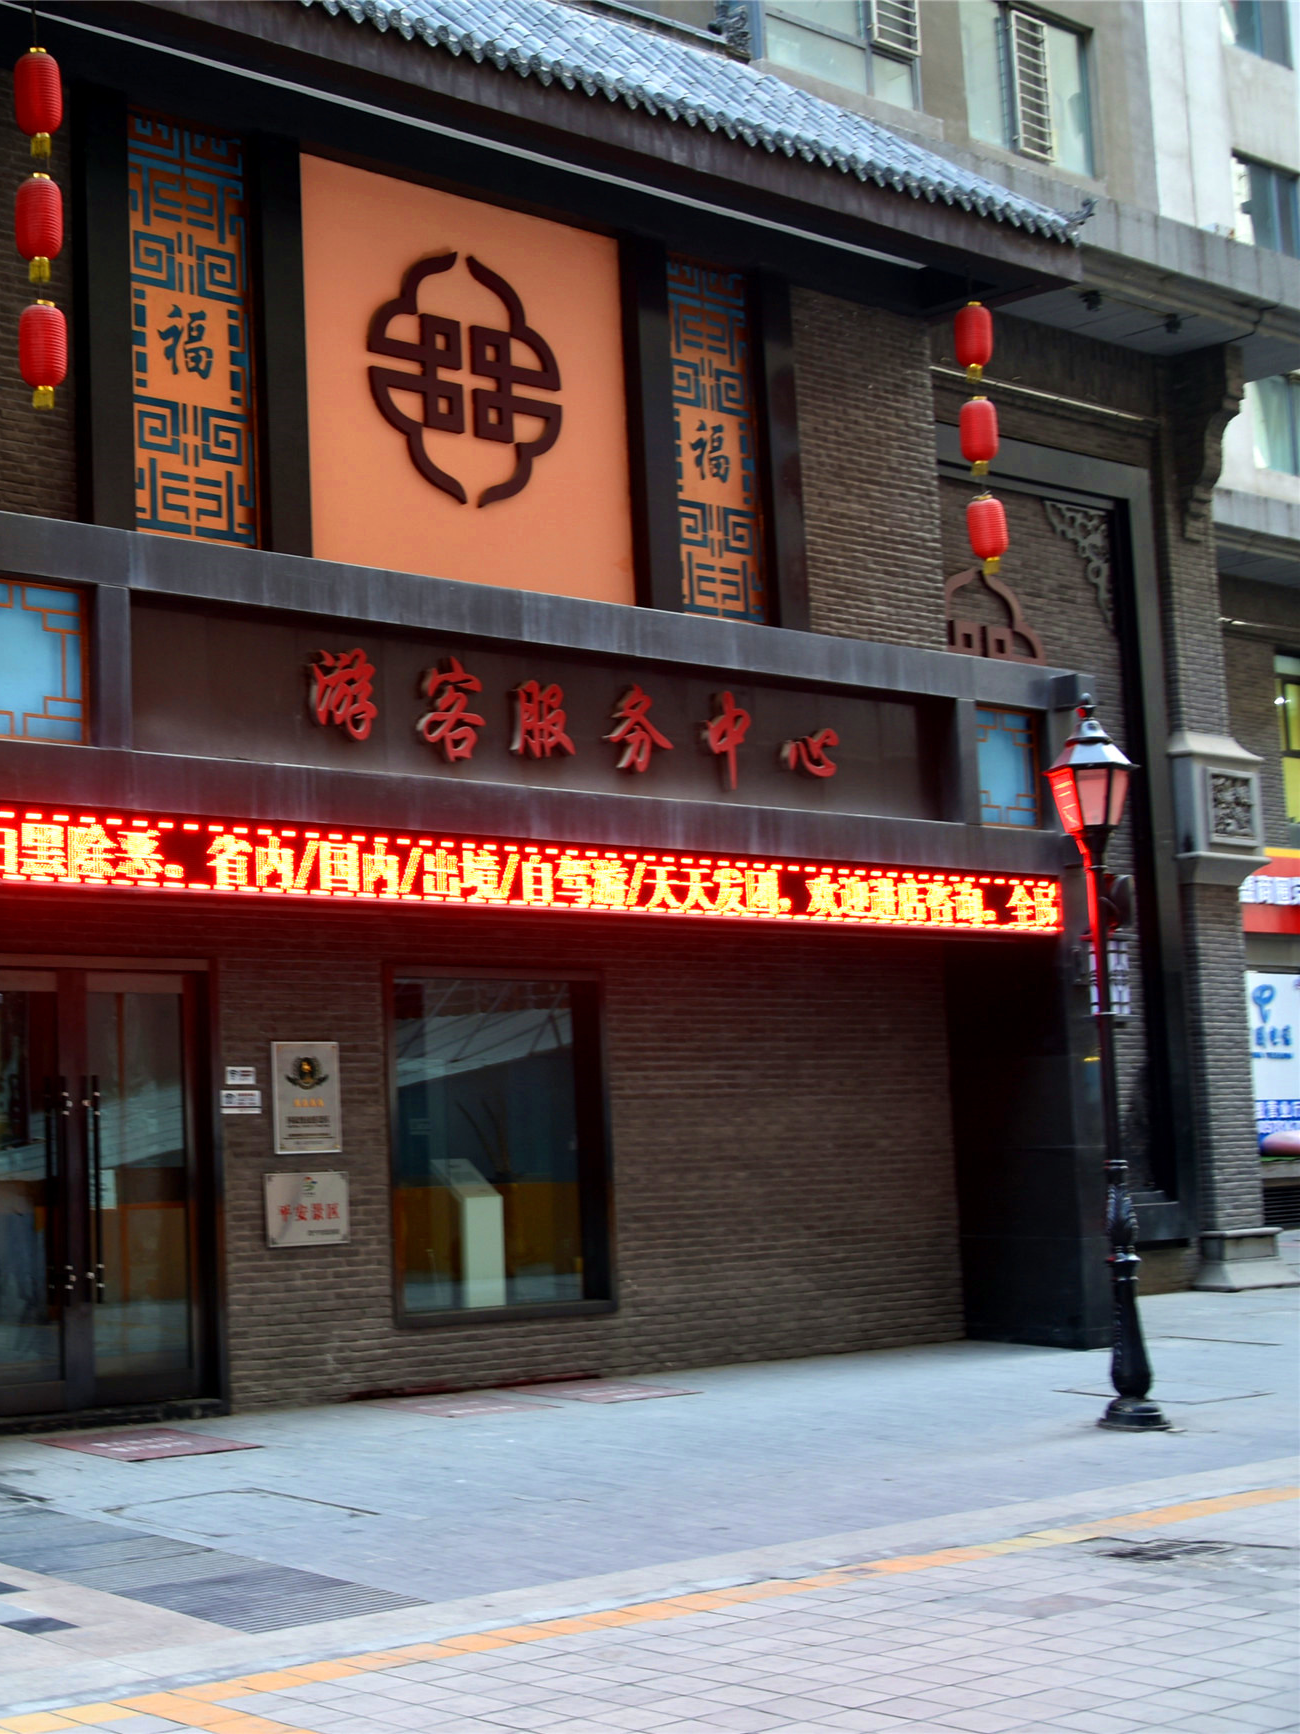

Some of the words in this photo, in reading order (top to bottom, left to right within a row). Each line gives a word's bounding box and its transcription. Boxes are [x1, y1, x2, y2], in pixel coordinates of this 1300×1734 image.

[157, 304, 213, 379] 福
[689, 420, 730, 483] 福
[310, 647, 839, 790] 游客服务中心
